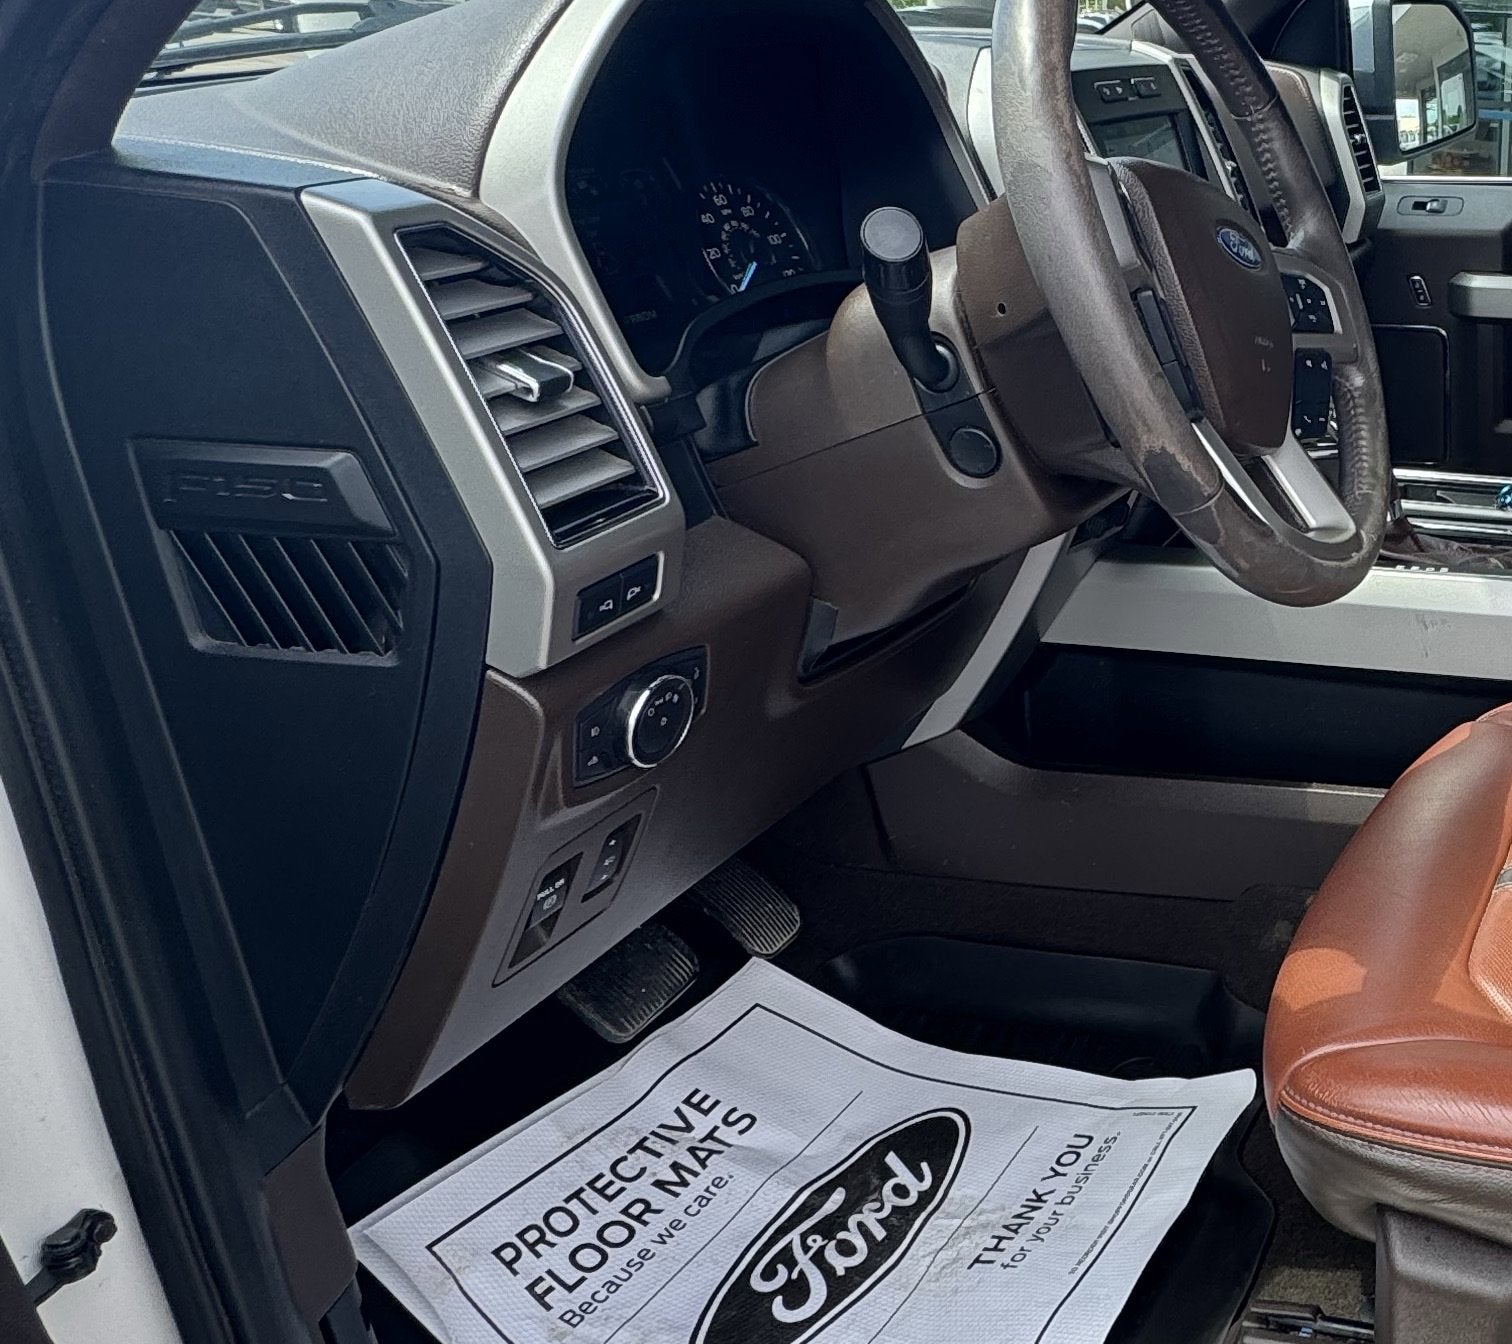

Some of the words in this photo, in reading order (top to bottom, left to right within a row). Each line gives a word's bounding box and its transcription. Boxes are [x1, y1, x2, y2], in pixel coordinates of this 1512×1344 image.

[491, 1088, 721, 1276] PROTECTIVE
[525, 1198, 664, 1311] FLOOR
[650, 1107, 757, 1198] MATS
[558, 1248, 655, 1328] Because
[651, 1219, 686, 1244] we
[684, 1174, 734, 1217] care.
[750, 1150, 932, 1323] Ford
[967, 1189, 1056, 1269] THANK
[1041, 1134, 1093, 1181] YOU
[1001, 1246, 1031, 1269] for
[1026, 1210, 1063, 1242] your
[1055, 1131, 1121, 1205] business.
